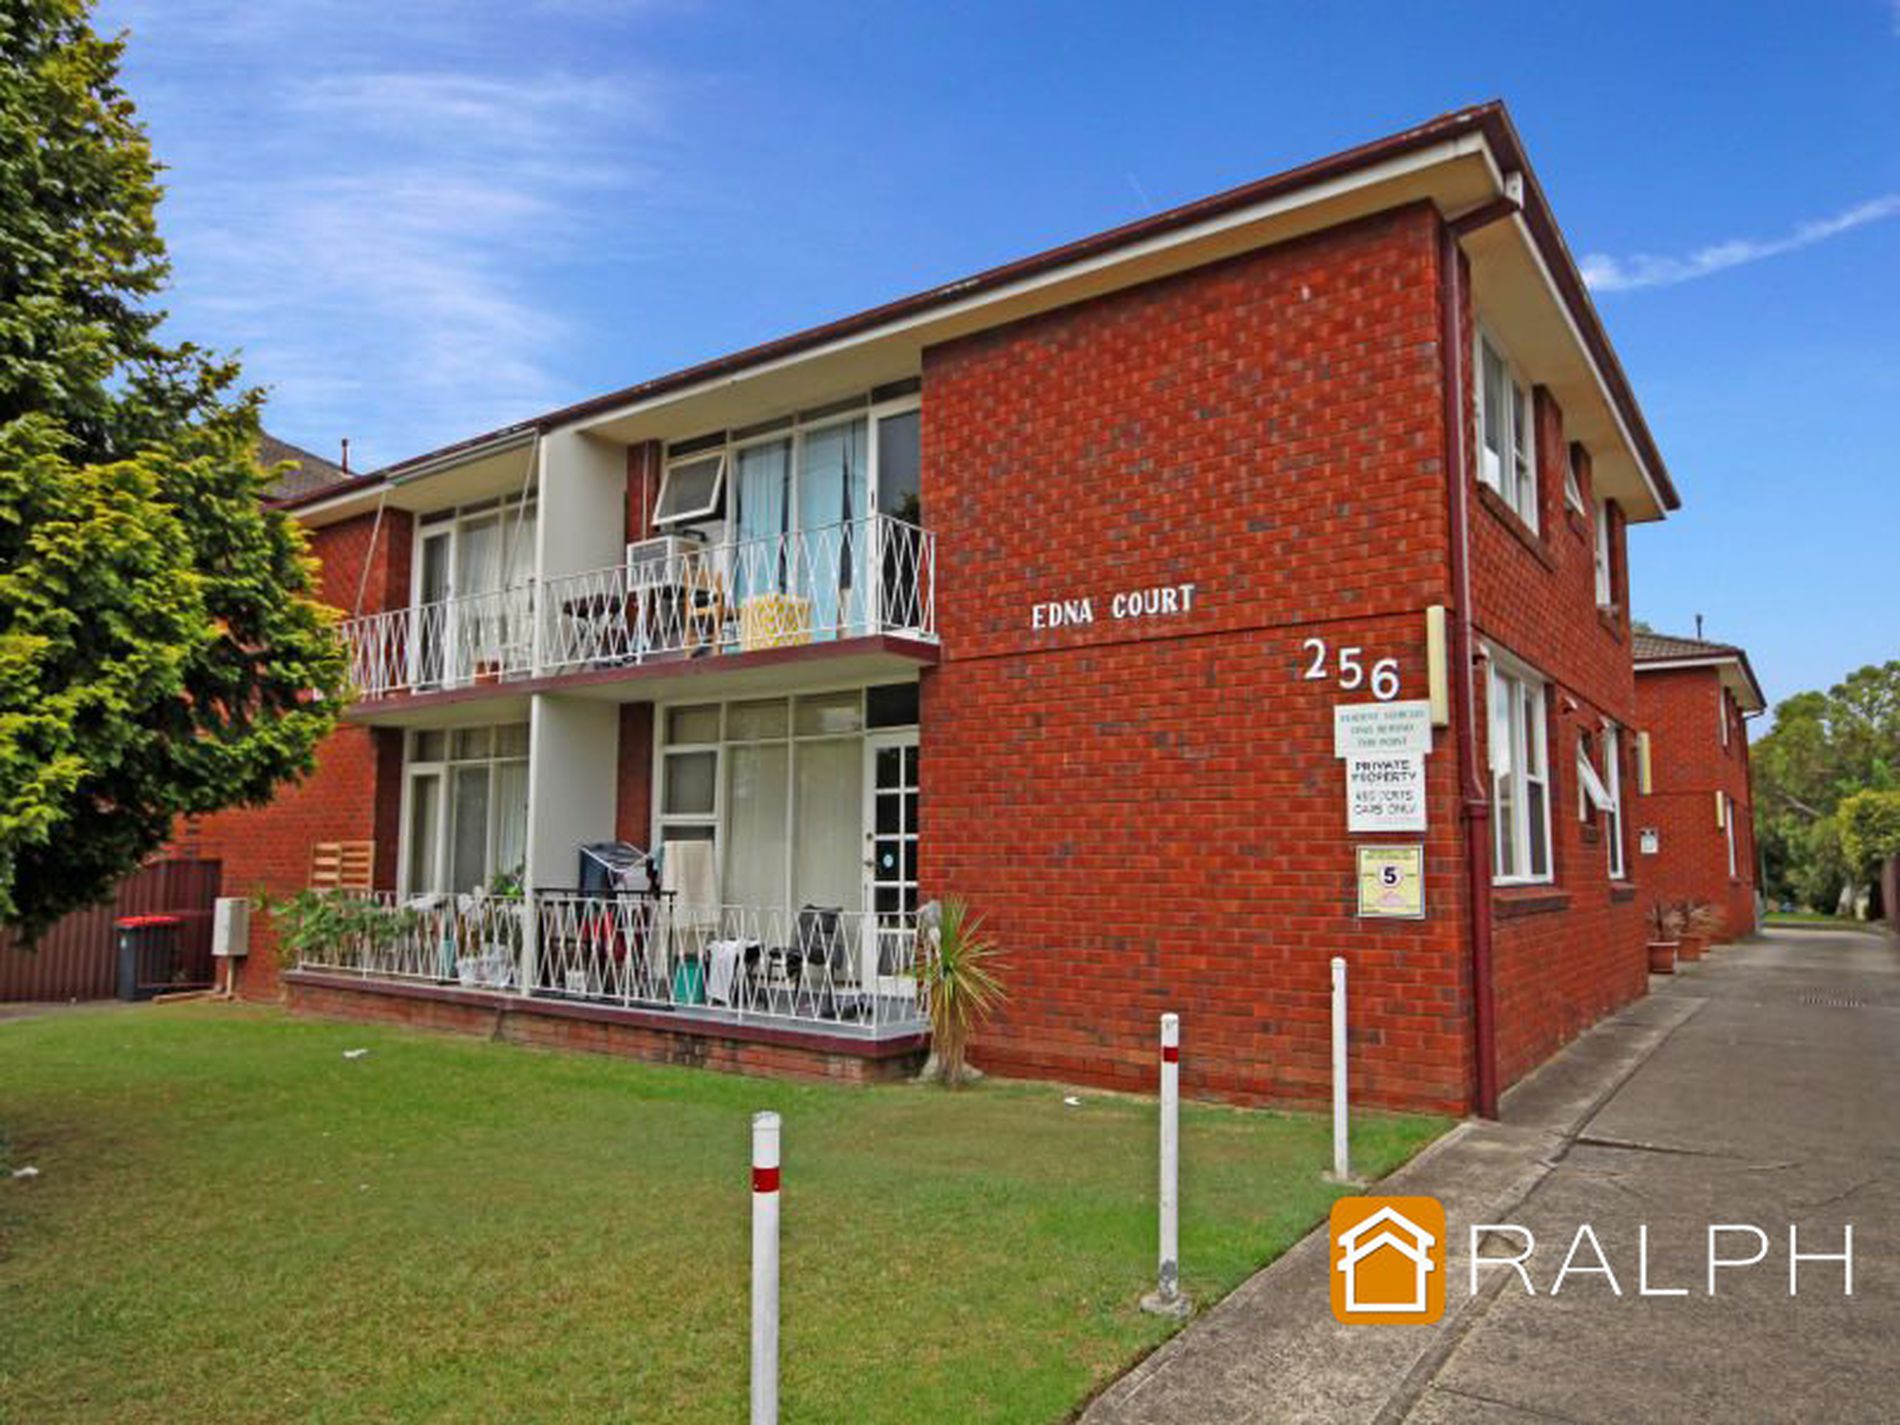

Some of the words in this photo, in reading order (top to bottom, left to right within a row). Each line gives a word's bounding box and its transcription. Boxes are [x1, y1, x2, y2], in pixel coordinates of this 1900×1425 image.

[1032, 598, 1093, 630] EDNA
[1112, 583, 1196, 619] COURT
[1303, 637, 1400, 701] 256
[1355, 759, 1410, 771] PRIVATE
[1351, 771, 1417, 783] PROPERTY
[1383, 866, 1398, 885] 5
